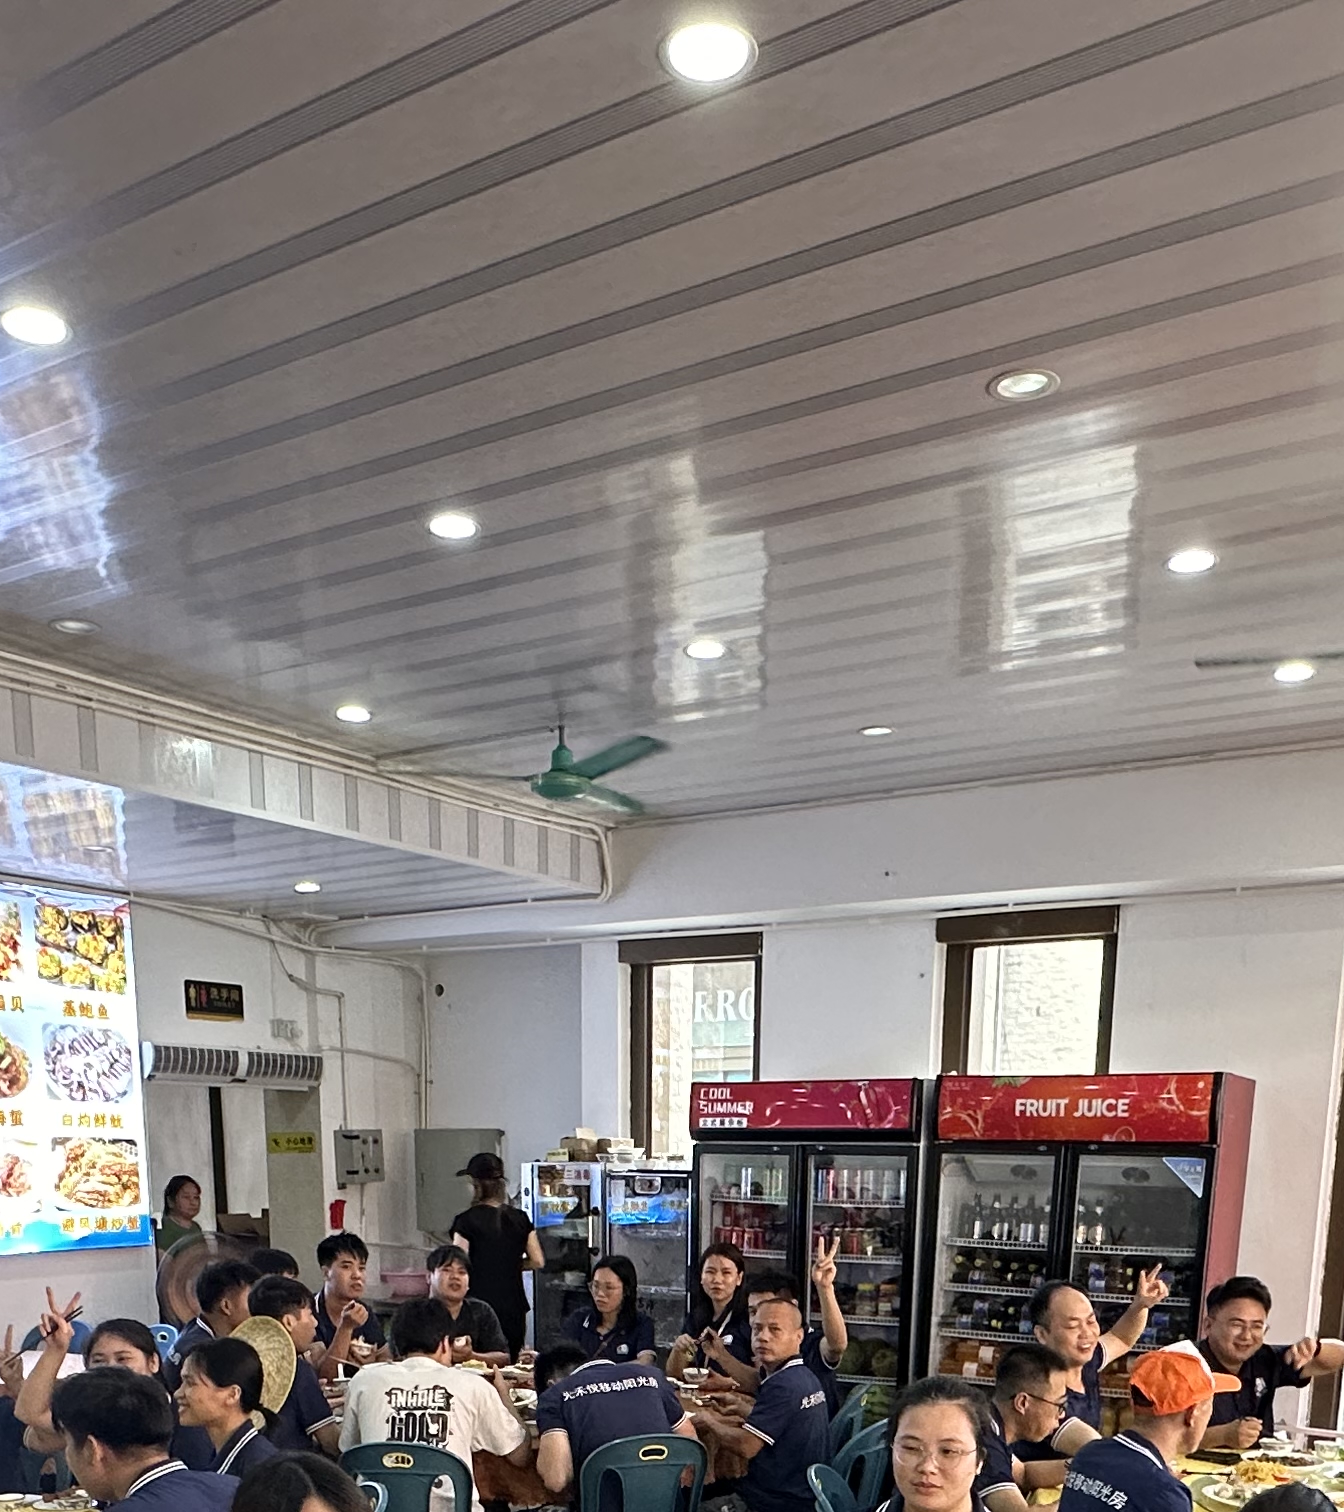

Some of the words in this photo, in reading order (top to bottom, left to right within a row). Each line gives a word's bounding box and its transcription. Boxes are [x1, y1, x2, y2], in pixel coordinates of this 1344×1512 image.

[62, 1000, 110, 1020] 蒸鲍鱼
[699, 1087, 734, 1100] COOL
[698, 1100, 754, 1115] SUMMER
[1014, 1098, 1069, 1119] FRUIT
[1073, 1098, 1131, 1119] JUICE
